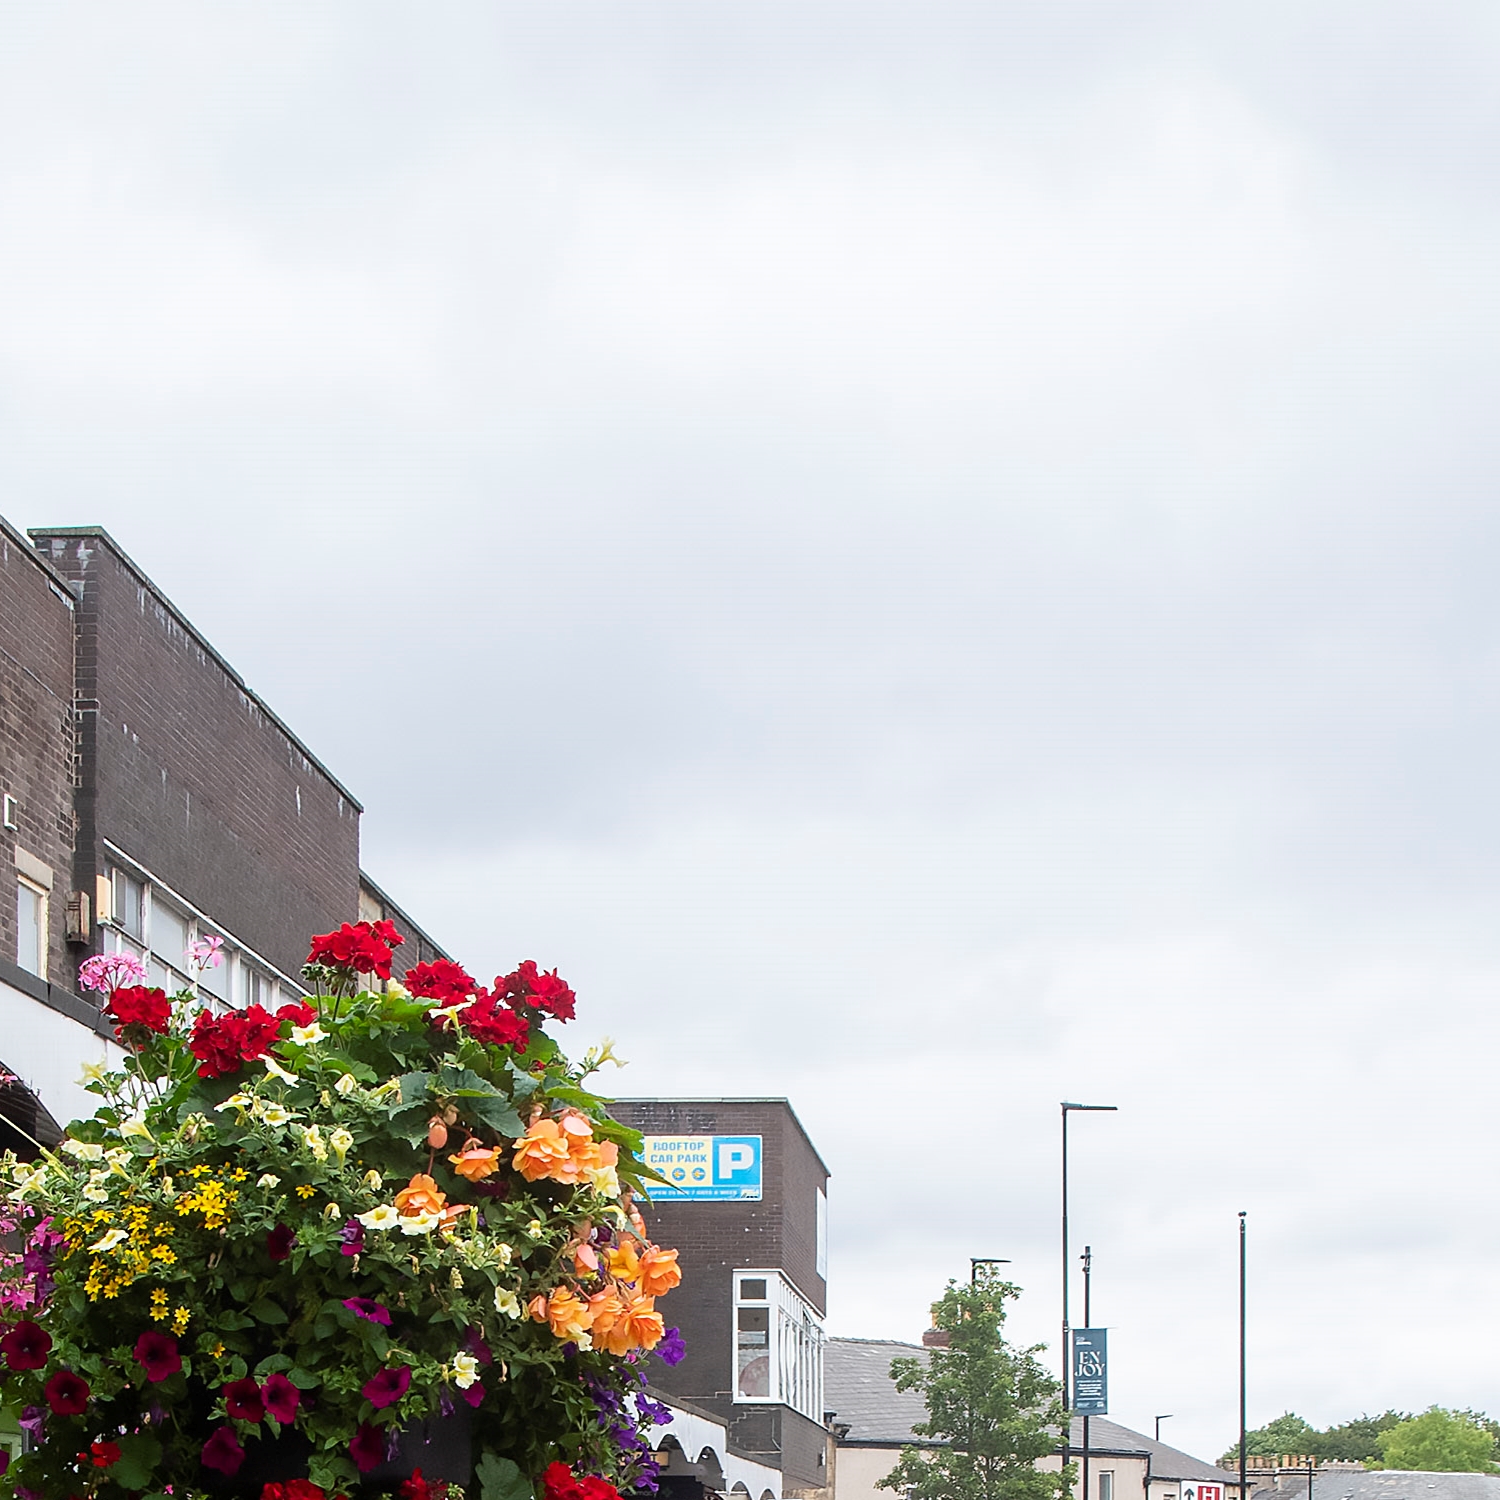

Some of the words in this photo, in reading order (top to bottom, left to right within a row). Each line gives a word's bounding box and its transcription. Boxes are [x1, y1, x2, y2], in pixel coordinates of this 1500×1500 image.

[653, 1141, 705, 1151] ROOFTOP
[650, 1154, 674, 1163] CAR
[676, 1154, 708, 1163] PARK
[718, 1143, 755, 1179] P
[1079, 1350, 1101, 1364] EN
[1073, 1363, 1106, 1377] JOY
